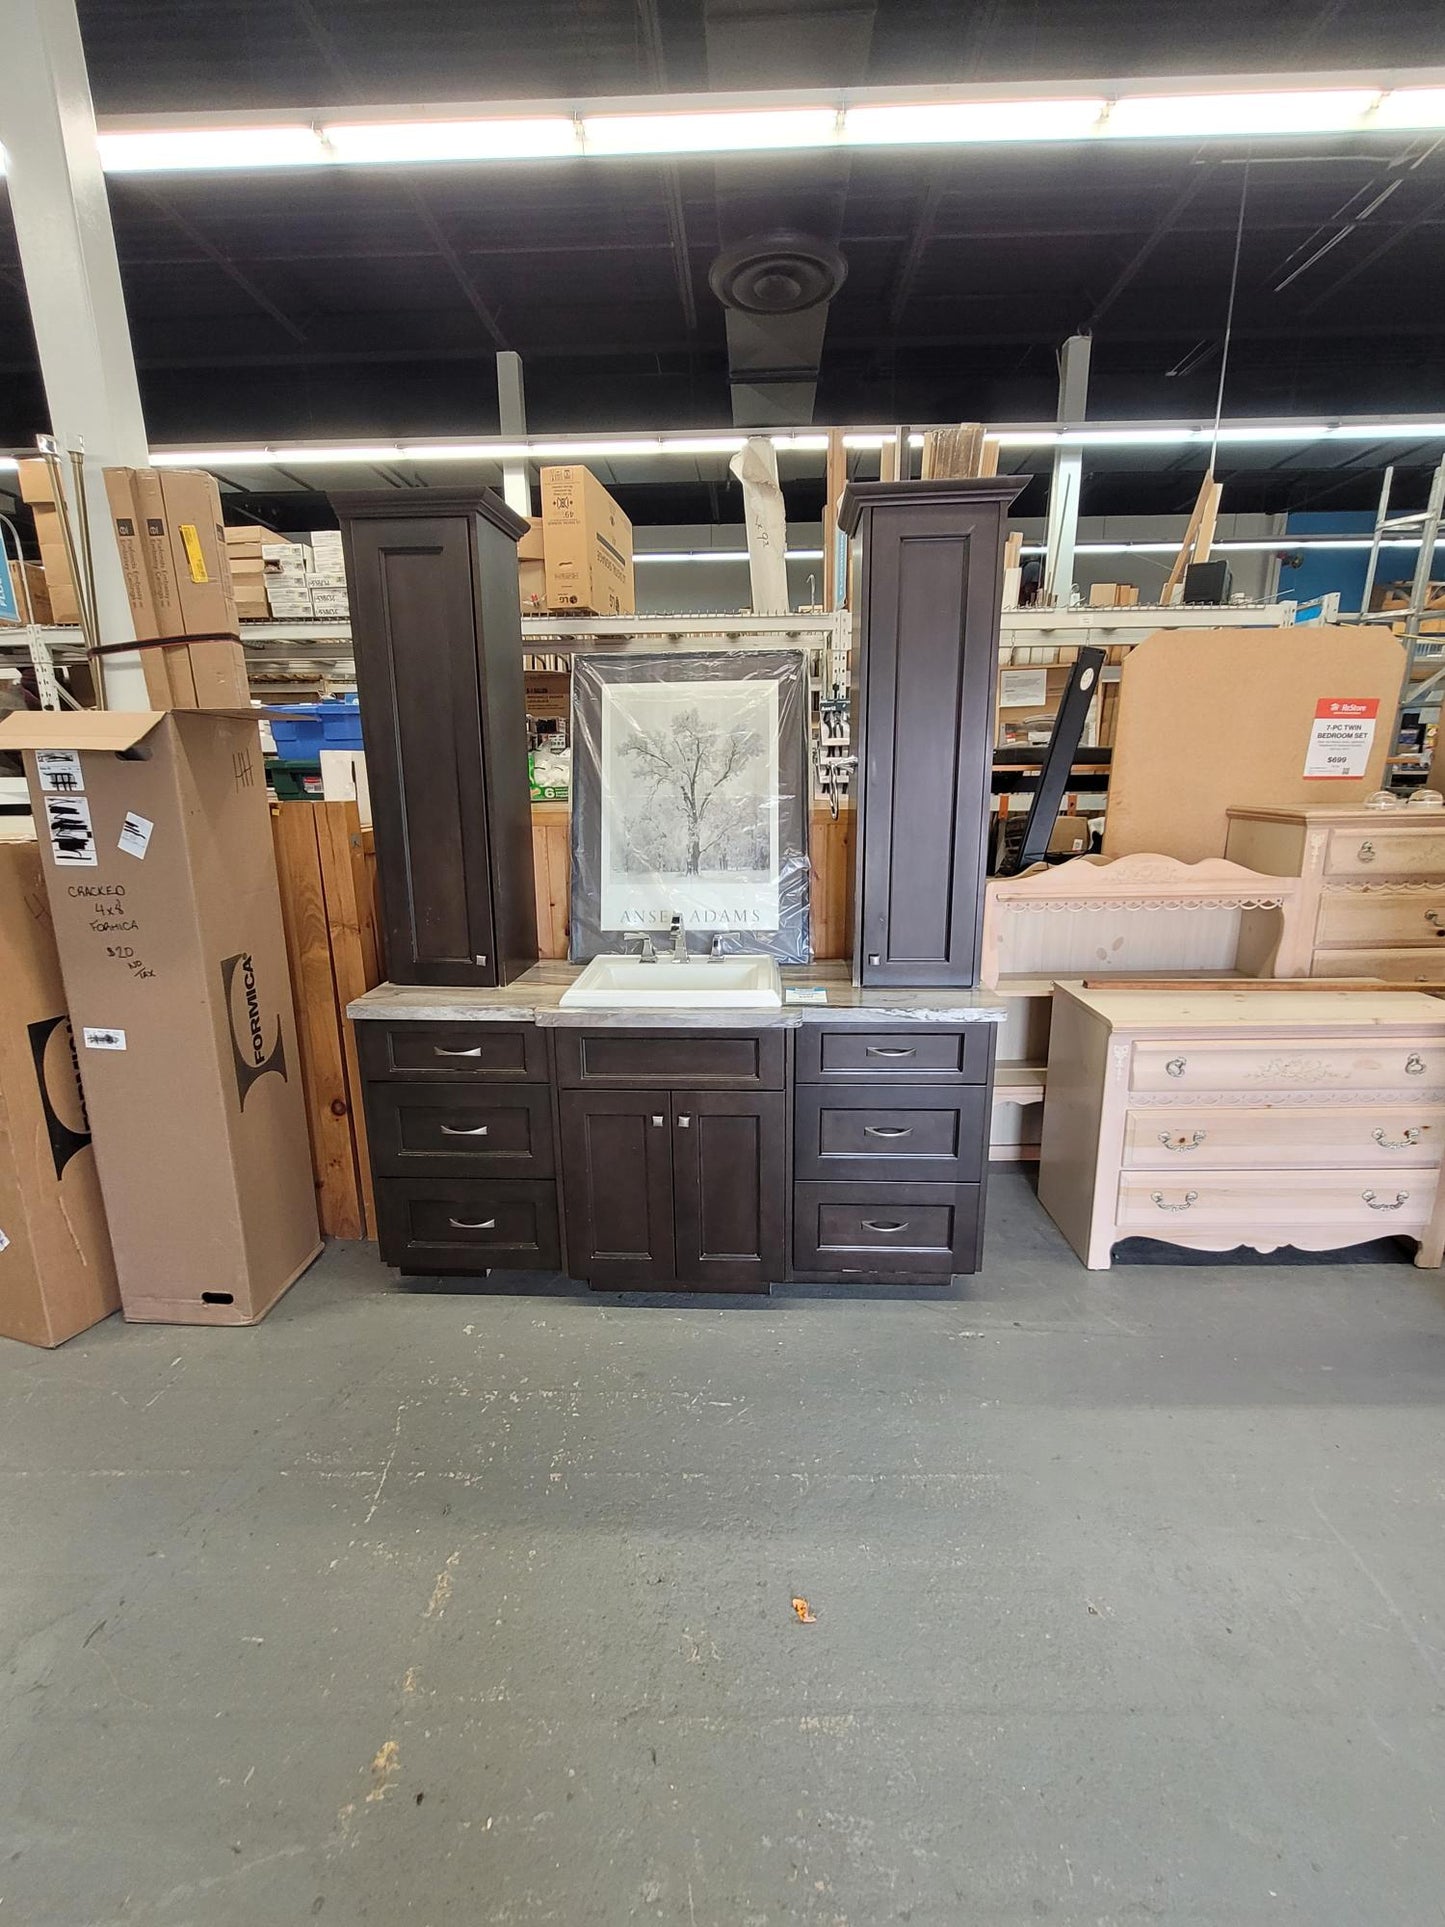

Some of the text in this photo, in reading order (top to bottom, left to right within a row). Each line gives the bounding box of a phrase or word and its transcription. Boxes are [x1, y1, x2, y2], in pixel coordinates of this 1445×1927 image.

[544, 788, 555, 799] 6
[67, 885, 126, 898] CRACKED
[620, 909, 760, 923] ANSE ADAMS
[89, 920, 139, 932] FORMICA
[106, 945, 134, 959] $20
[242, 955, 265, 1065] FORMICA
